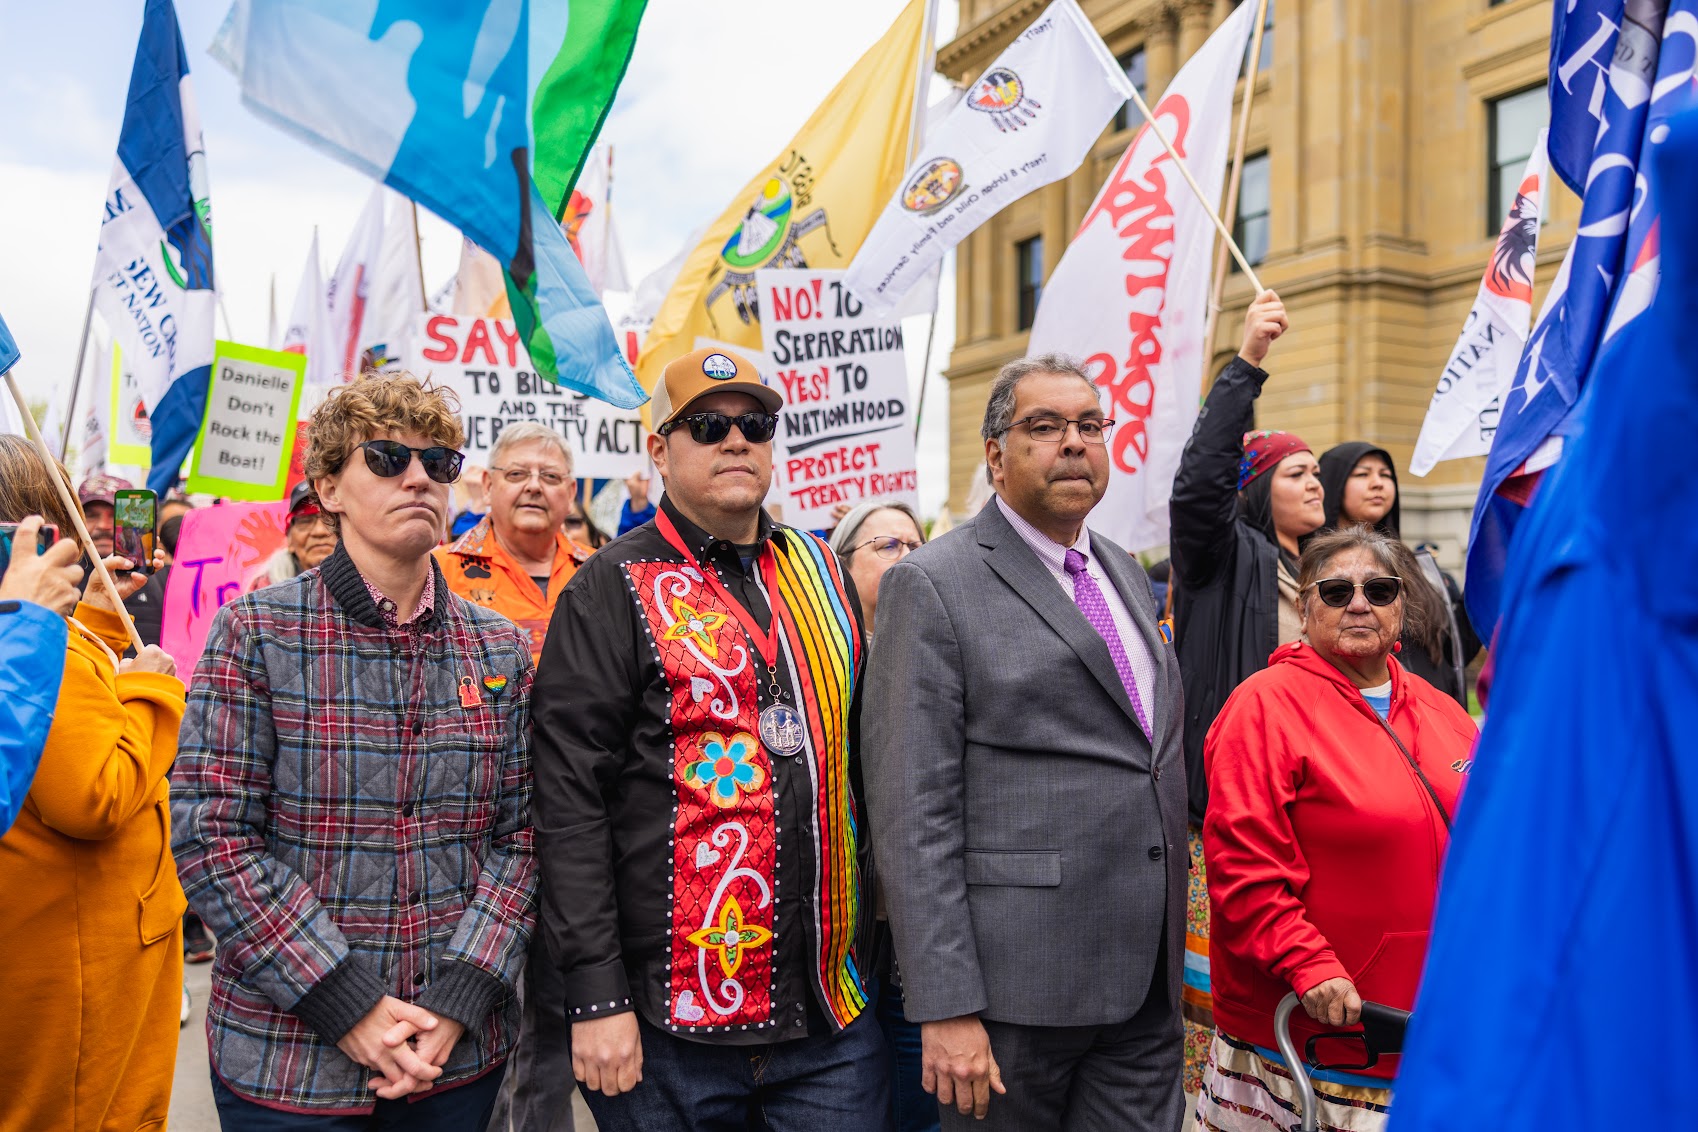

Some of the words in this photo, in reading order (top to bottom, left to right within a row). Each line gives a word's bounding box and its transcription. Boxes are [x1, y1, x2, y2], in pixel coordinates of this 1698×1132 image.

[771, 279, 823, 321] NO!
[830, 281, 863, 318] TO
[121, 292, 165, 359] NATION
[422, 315, 520, 368] SAY
[772, 326, 904, 365] SEPARATION
[222, 367, 290, 392] Danielle
[465, 371, 500, 395] TO
[778, 366, 830, 405] YES!
[836, 363, 868, 394] TO
[228, 396, 274, 417] Don't
[499, 400, 536, 415] AND
[547, 403, 585, 416] THE
[784, 399, 905, 437] NATIONHOOD
[210, 421, 250, 441] Rock
[256, 430, 281, 446] the
[596, 419, 644, 454] ACT
[219, 450, 265, 471] Boat!
[787, 443, 880, 483] PROTECT
[790, 476, 866, 510] TREATY
[869, 470, 918, 496] RIGHTS
